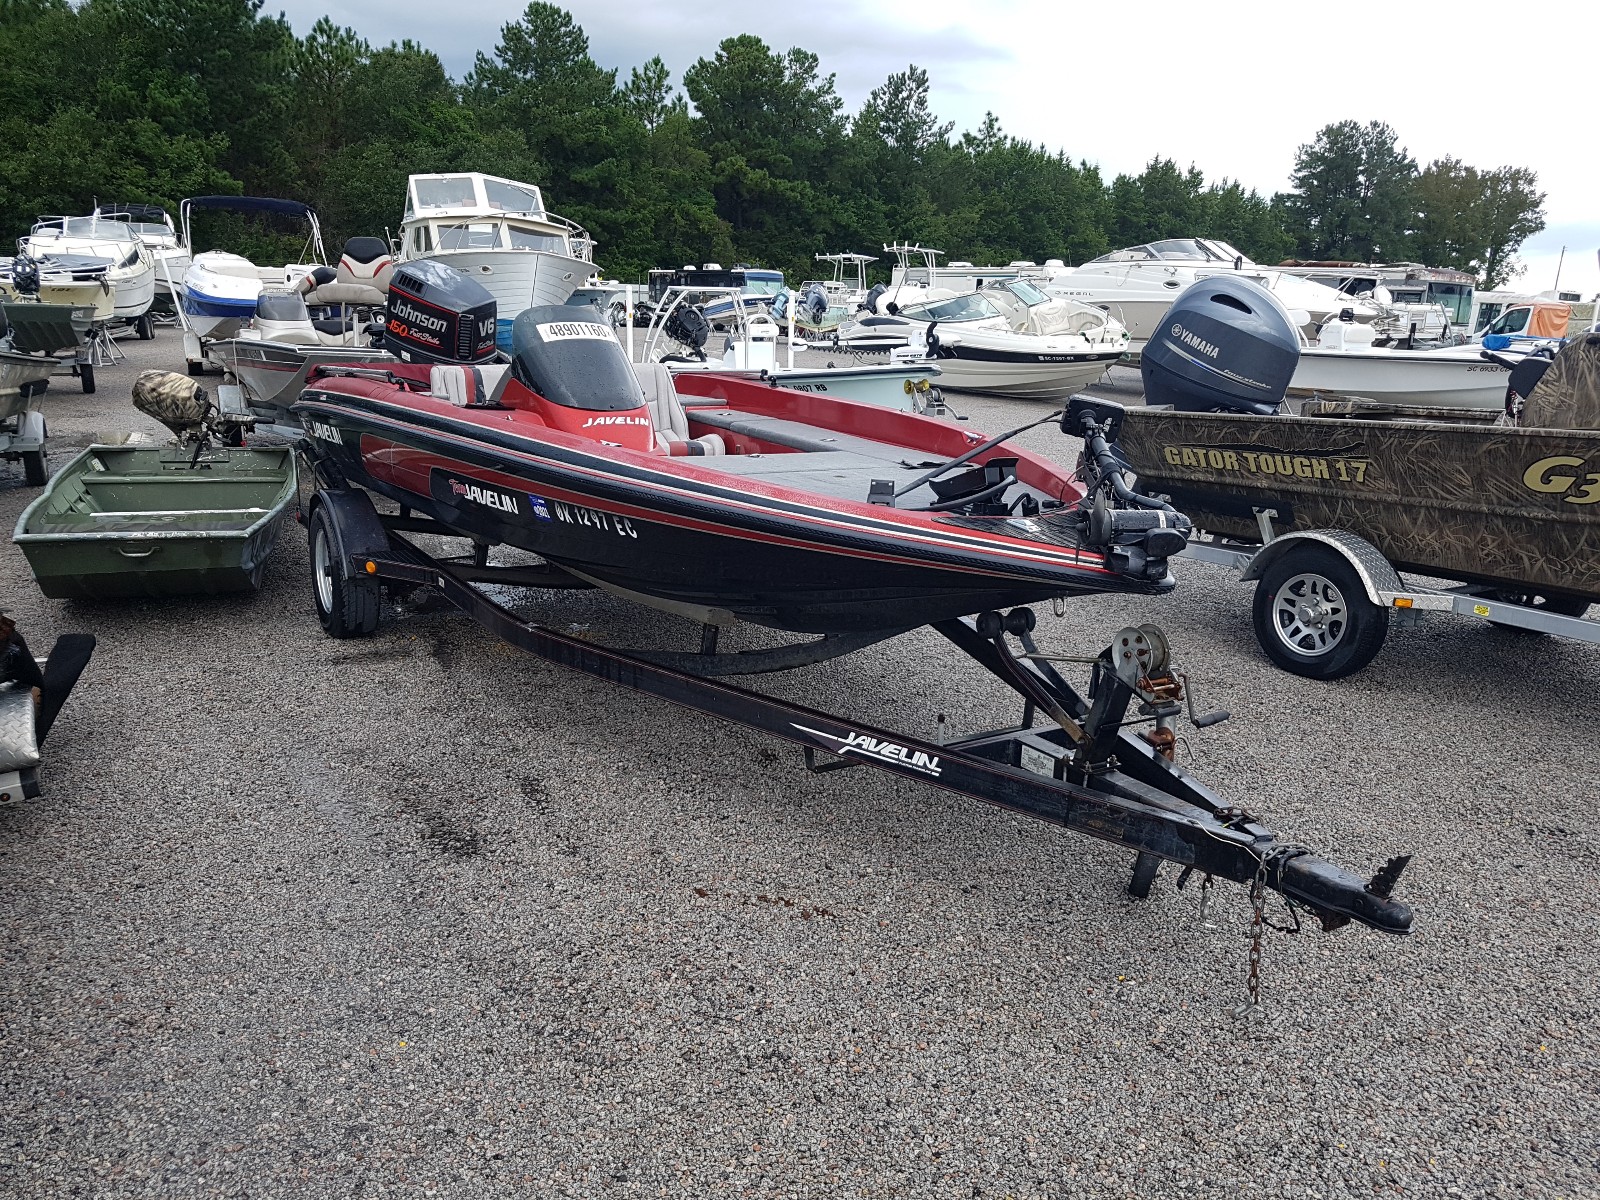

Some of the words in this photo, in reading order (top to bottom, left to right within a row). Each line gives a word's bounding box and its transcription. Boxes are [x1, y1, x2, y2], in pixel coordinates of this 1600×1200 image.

[389, 319, 408, 337] 150
[390, 299, 448, 333] Johnson
[478, 316, 495, 337] V6
[549, 323, 607, 338] 48901160
[1181, 328, 1220, 359] YAMAHA
[814, 383, 828, 392] RB
[582, 416, 649, 428] JAVELIN
[1163, 446, 1240, 472] GATOR
[1242, 451, 1331, 481] TOUGH
[1335, 460, 1368, 483] 17
[1522, 455, 1600, 506] G3
[465, 483, 520, 515] JAVELIN
[574, 506, 609, 532] 1297
[611, 514, 638, 540] EC
[842, 731, 942, 773] JAVELIN
